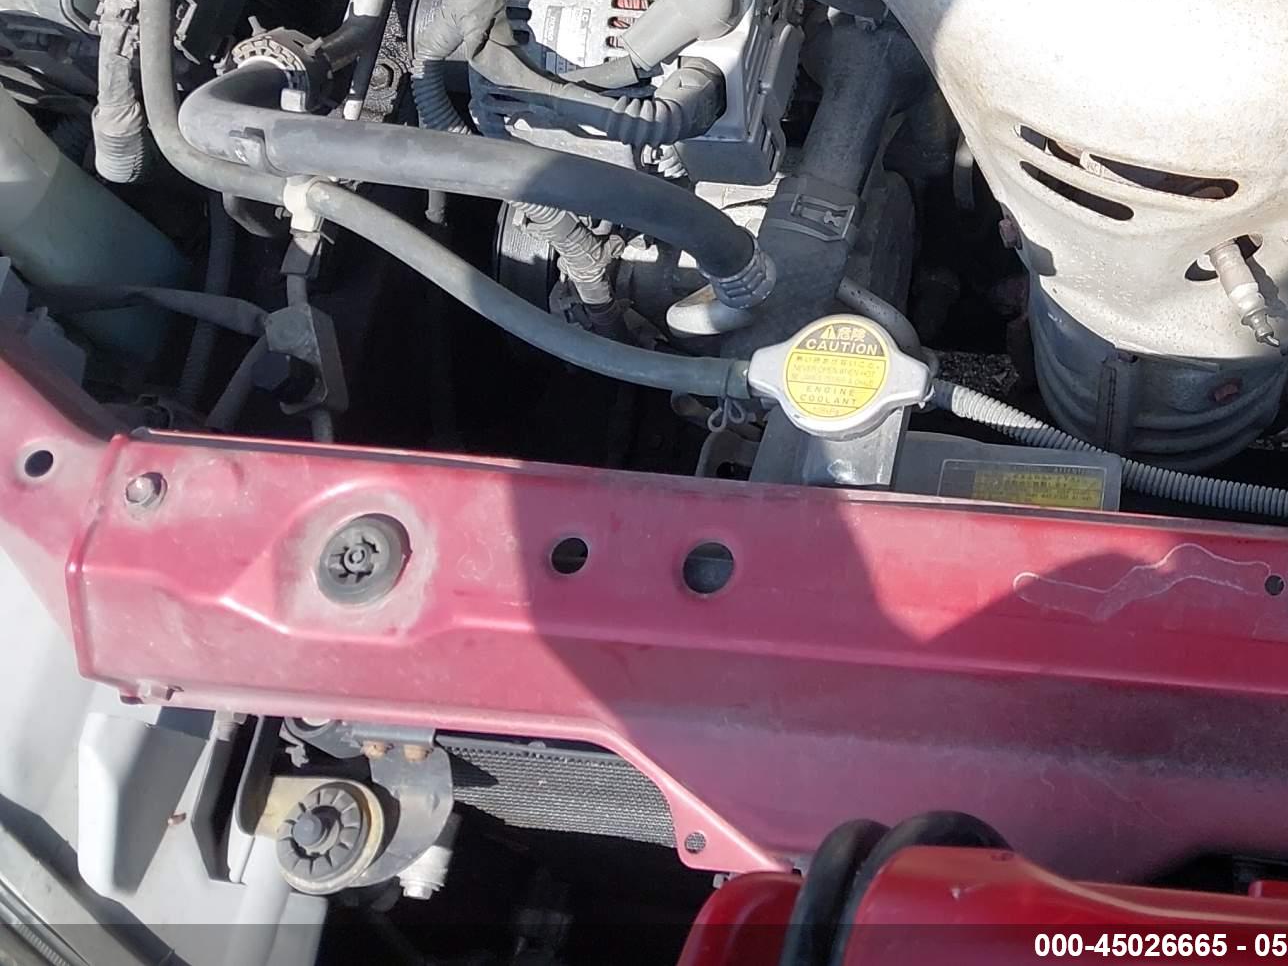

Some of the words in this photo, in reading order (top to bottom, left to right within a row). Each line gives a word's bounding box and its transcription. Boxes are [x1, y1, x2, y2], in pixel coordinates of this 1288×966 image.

[837, 326, 867, 342] 危険
[806, 338, 878, 356] CAUTION
[807, 386, 854, 396] ENGINE
[800, 394, 857, 405] COOLANT
